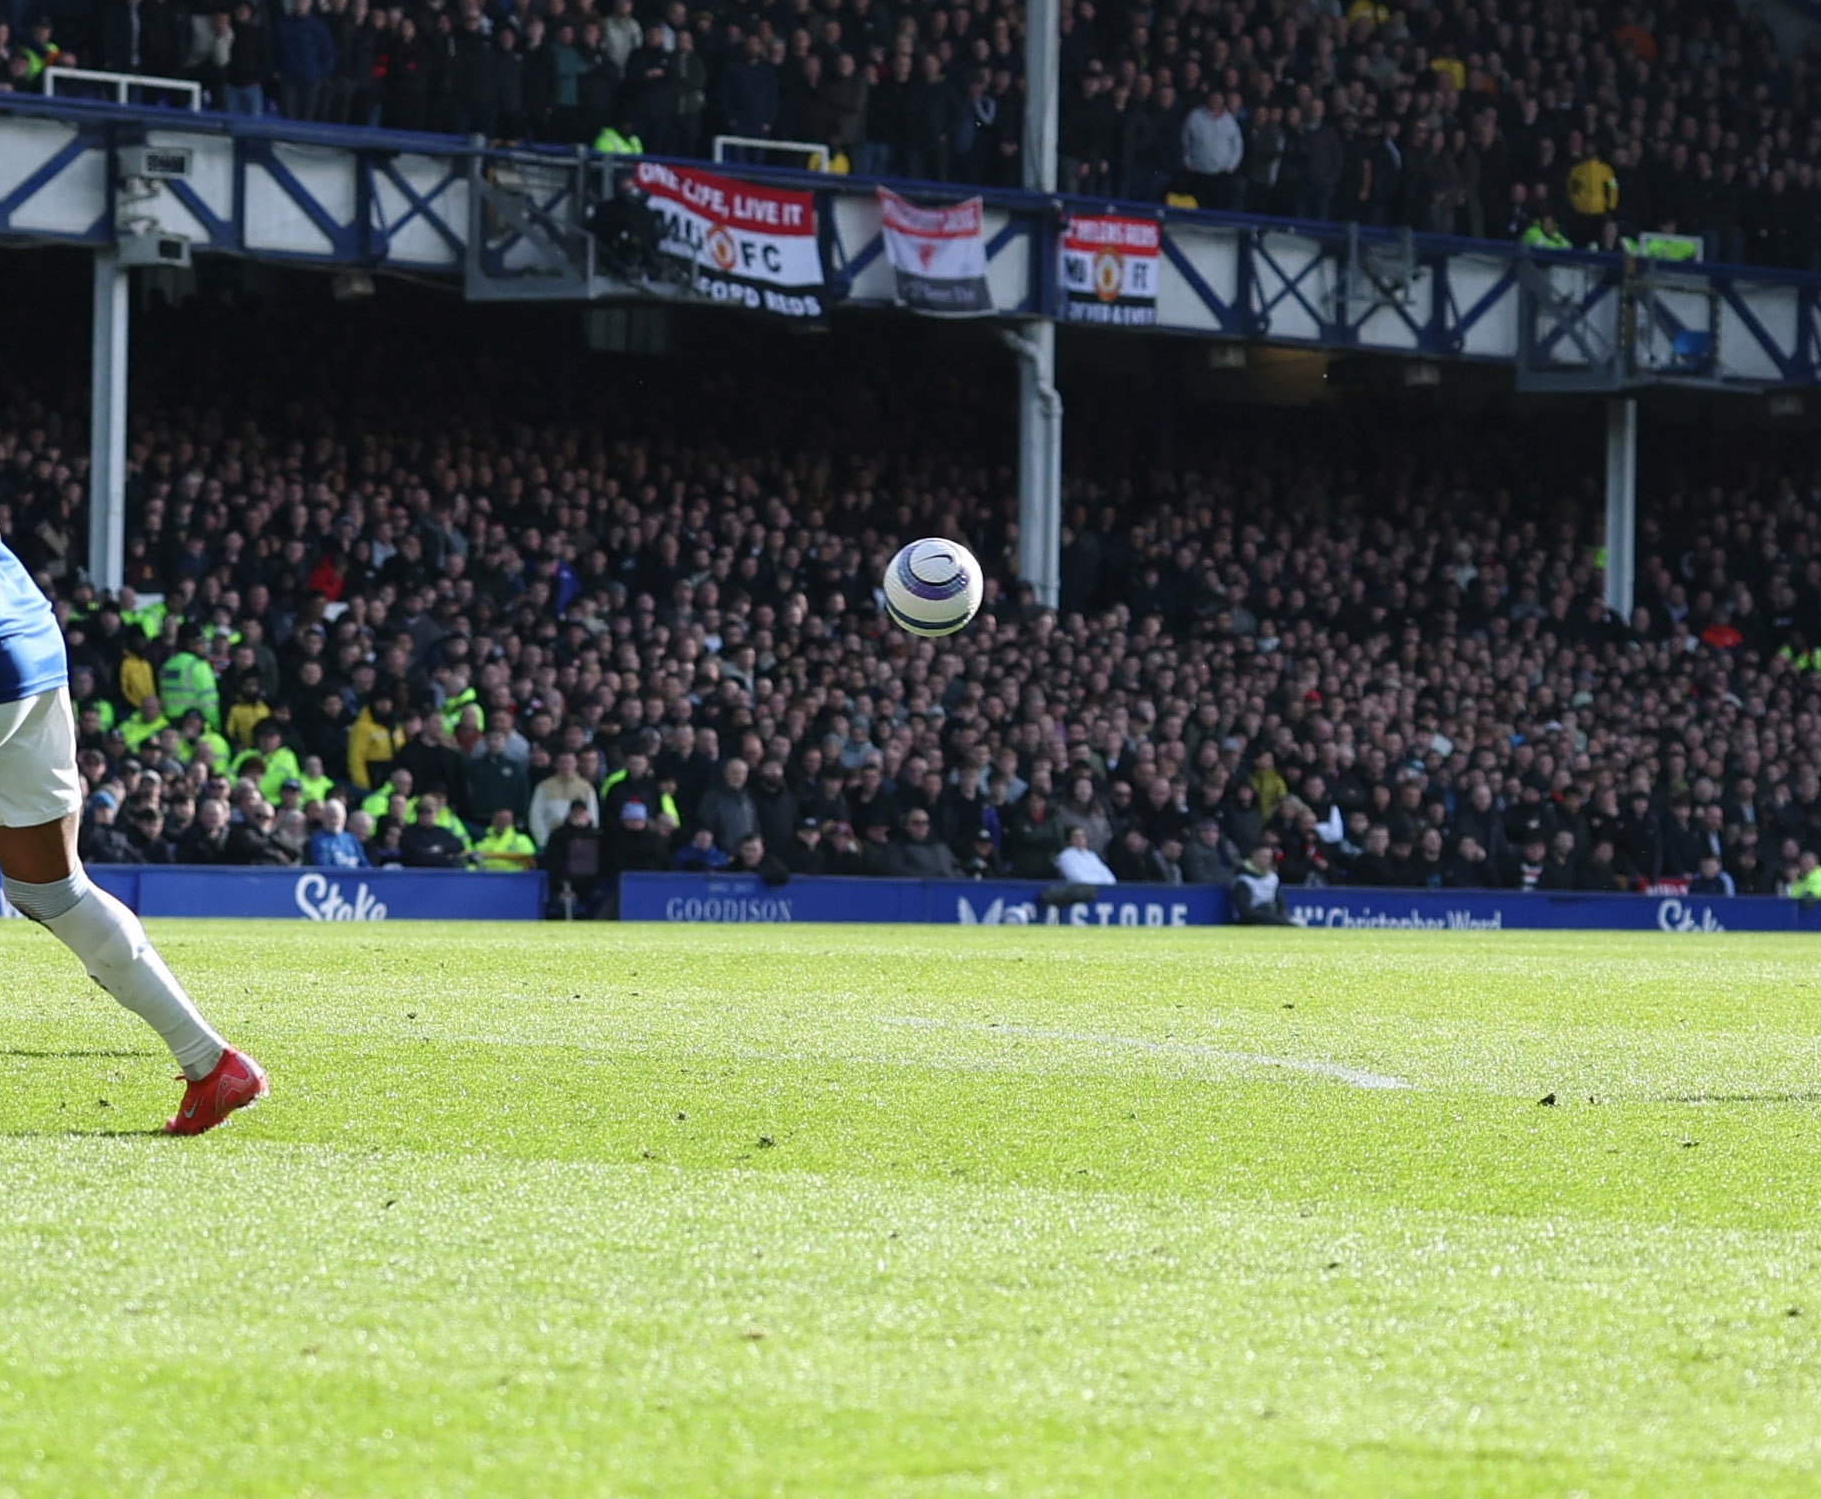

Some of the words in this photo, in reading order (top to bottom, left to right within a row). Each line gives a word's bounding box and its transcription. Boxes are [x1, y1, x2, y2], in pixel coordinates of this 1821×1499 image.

[733, 195, 780, 225] LIVE
[783, 203, 803, 226] IT
[740, 240, 781, 273] FC
[666, 897, 793, 922] GOODISON
